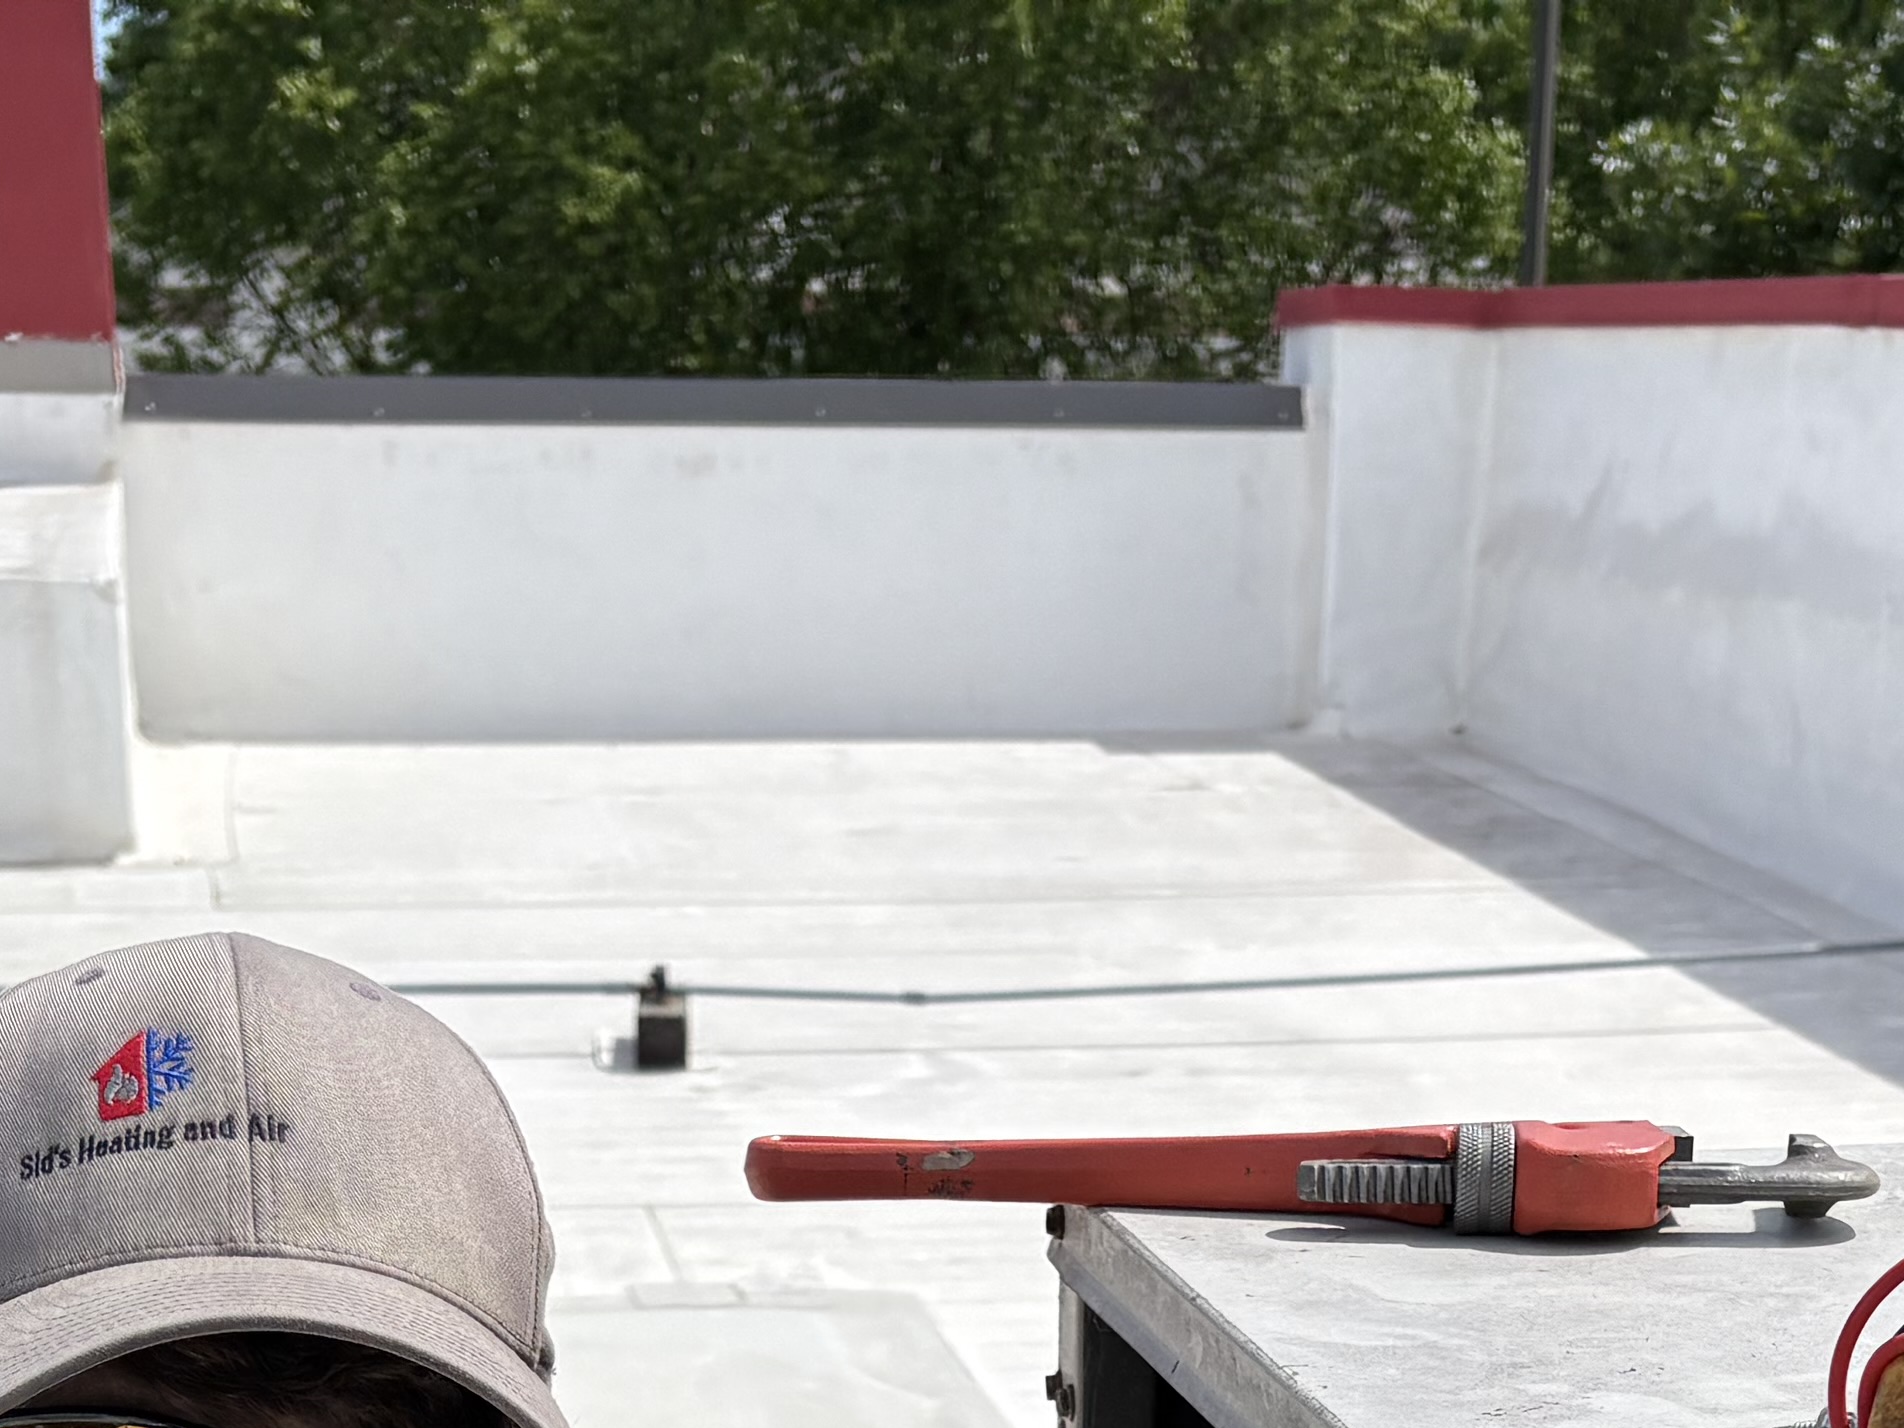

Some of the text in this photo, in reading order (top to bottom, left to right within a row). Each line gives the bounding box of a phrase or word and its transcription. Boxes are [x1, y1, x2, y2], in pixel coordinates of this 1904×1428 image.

[20, 1112, 291, 1180] Sid's Heating and Air
